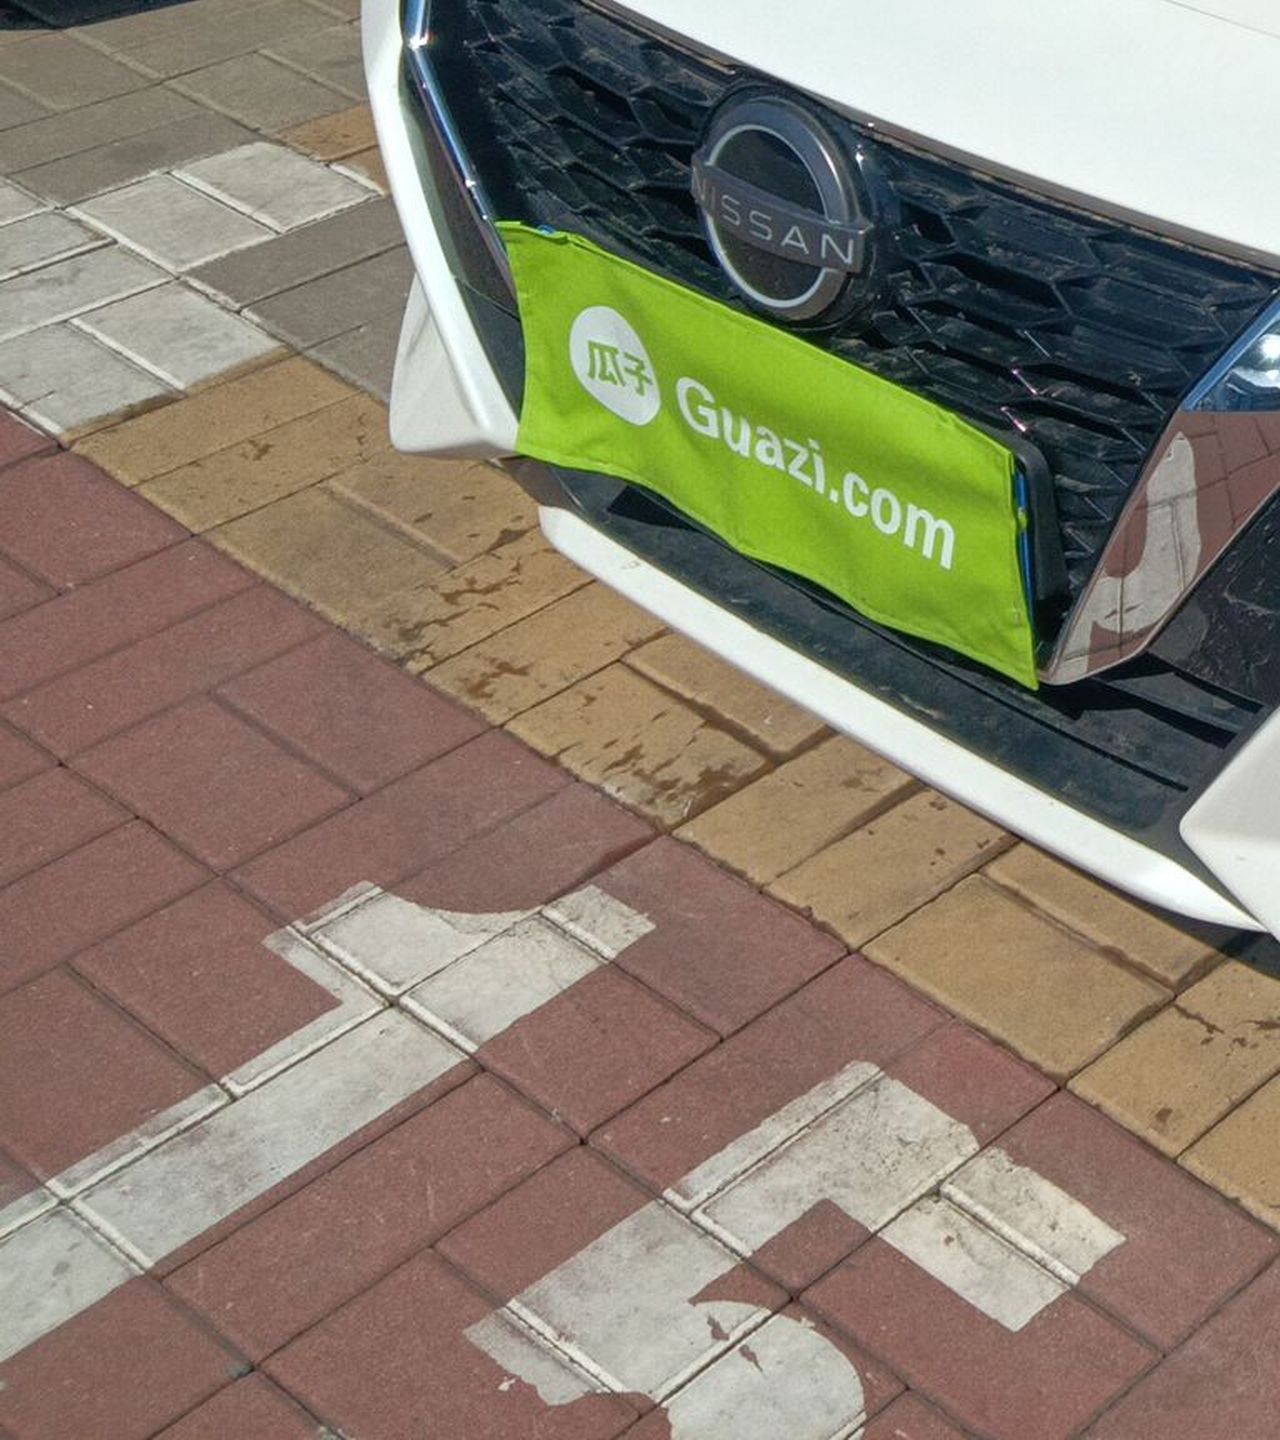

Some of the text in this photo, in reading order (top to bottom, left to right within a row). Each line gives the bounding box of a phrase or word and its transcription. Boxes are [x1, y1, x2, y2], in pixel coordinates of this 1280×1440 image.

[690, 162, 854, 266] NISSAN
[587, 340, 654, 397] 瓜子
[675, 377, 957, 570] Guazi.com
